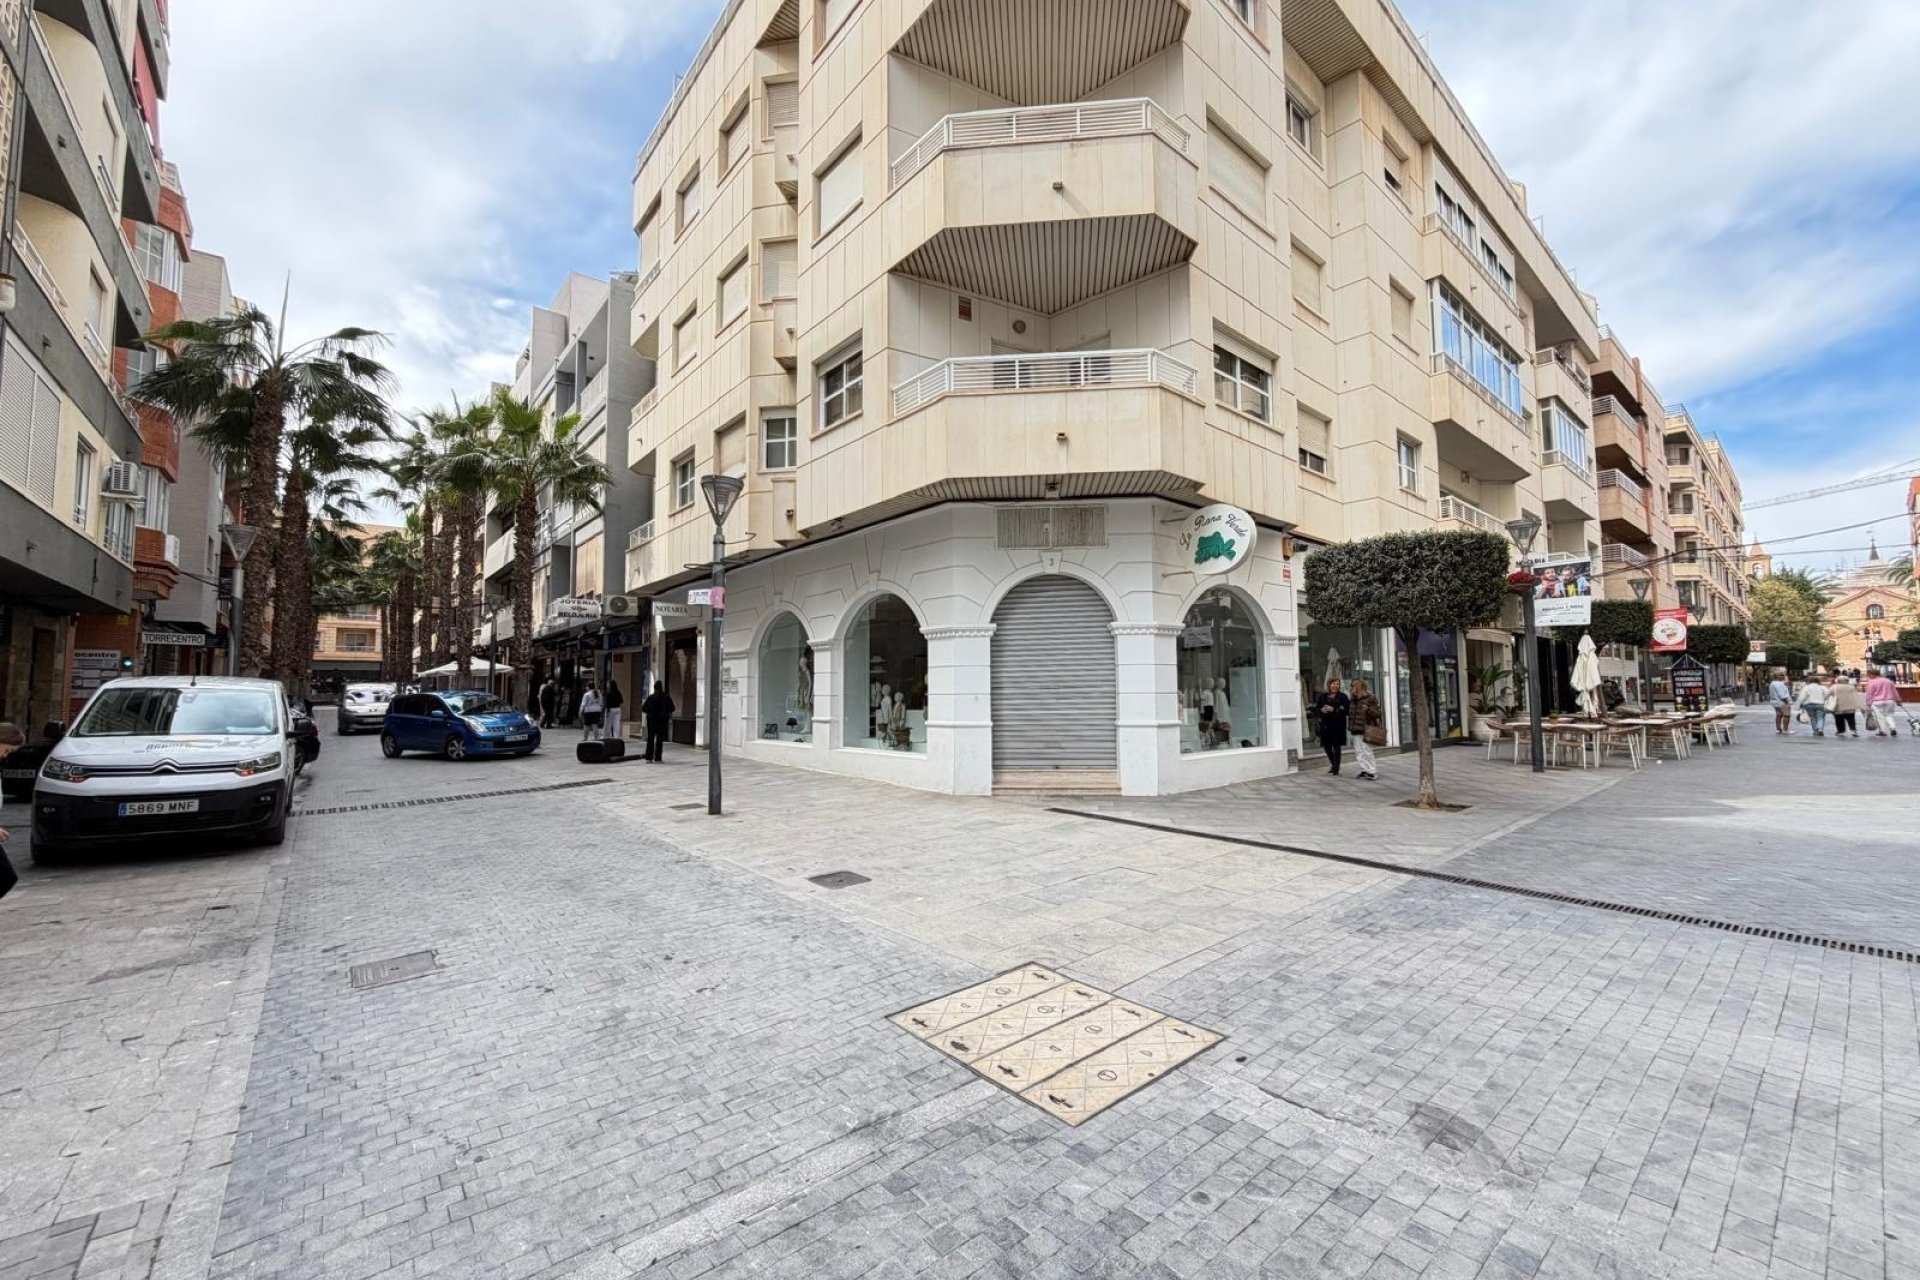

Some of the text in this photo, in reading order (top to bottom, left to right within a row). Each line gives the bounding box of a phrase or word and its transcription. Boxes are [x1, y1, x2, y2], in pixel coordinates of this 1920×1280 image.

[559, 597, 598, 606] JOYERIA
[655, 604, 689, 614] NOTARIA
[144, 633, 204, 645] TORRECENTRO
[127, 800, 195, 814] 5869 MNF
